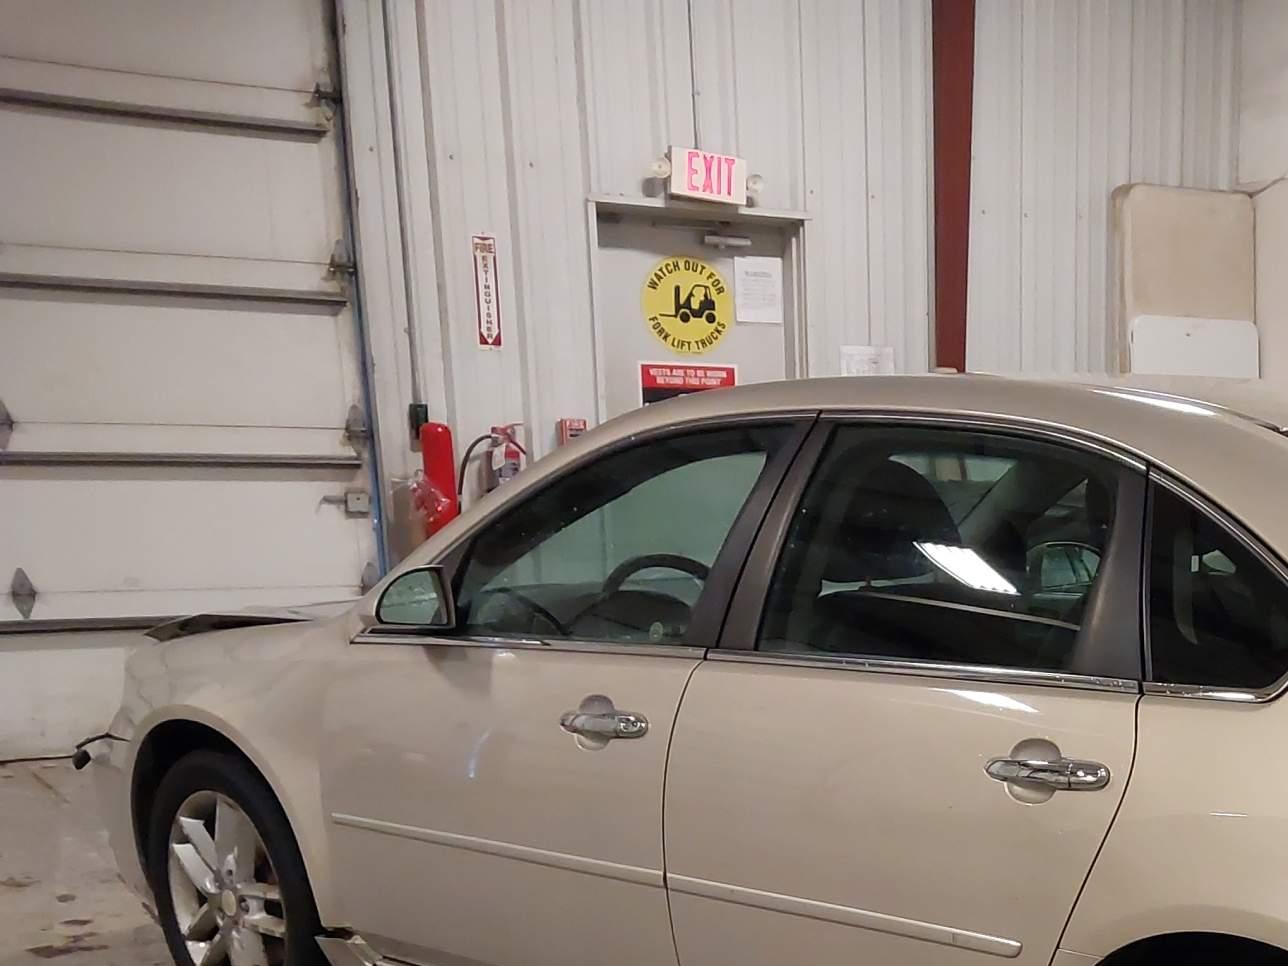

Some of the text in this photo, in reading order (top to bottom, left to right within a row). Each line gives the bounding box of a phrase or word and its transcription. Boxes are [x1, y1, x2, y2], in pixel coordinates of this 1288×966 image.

[687, 151, 736, 197] EXIT
[474, 242, 495, 254] FIRE
[647, 259, 681, 291] WATCH
[684, 259, 707, 276] OUT
[706, 273, 725, 295] FOR
[481, 255, 494, 340] EXTINGUISHER
[648, 316, 727, 351] FORK LIFT TRUCKS
[686, 369, 695, 377] TO
